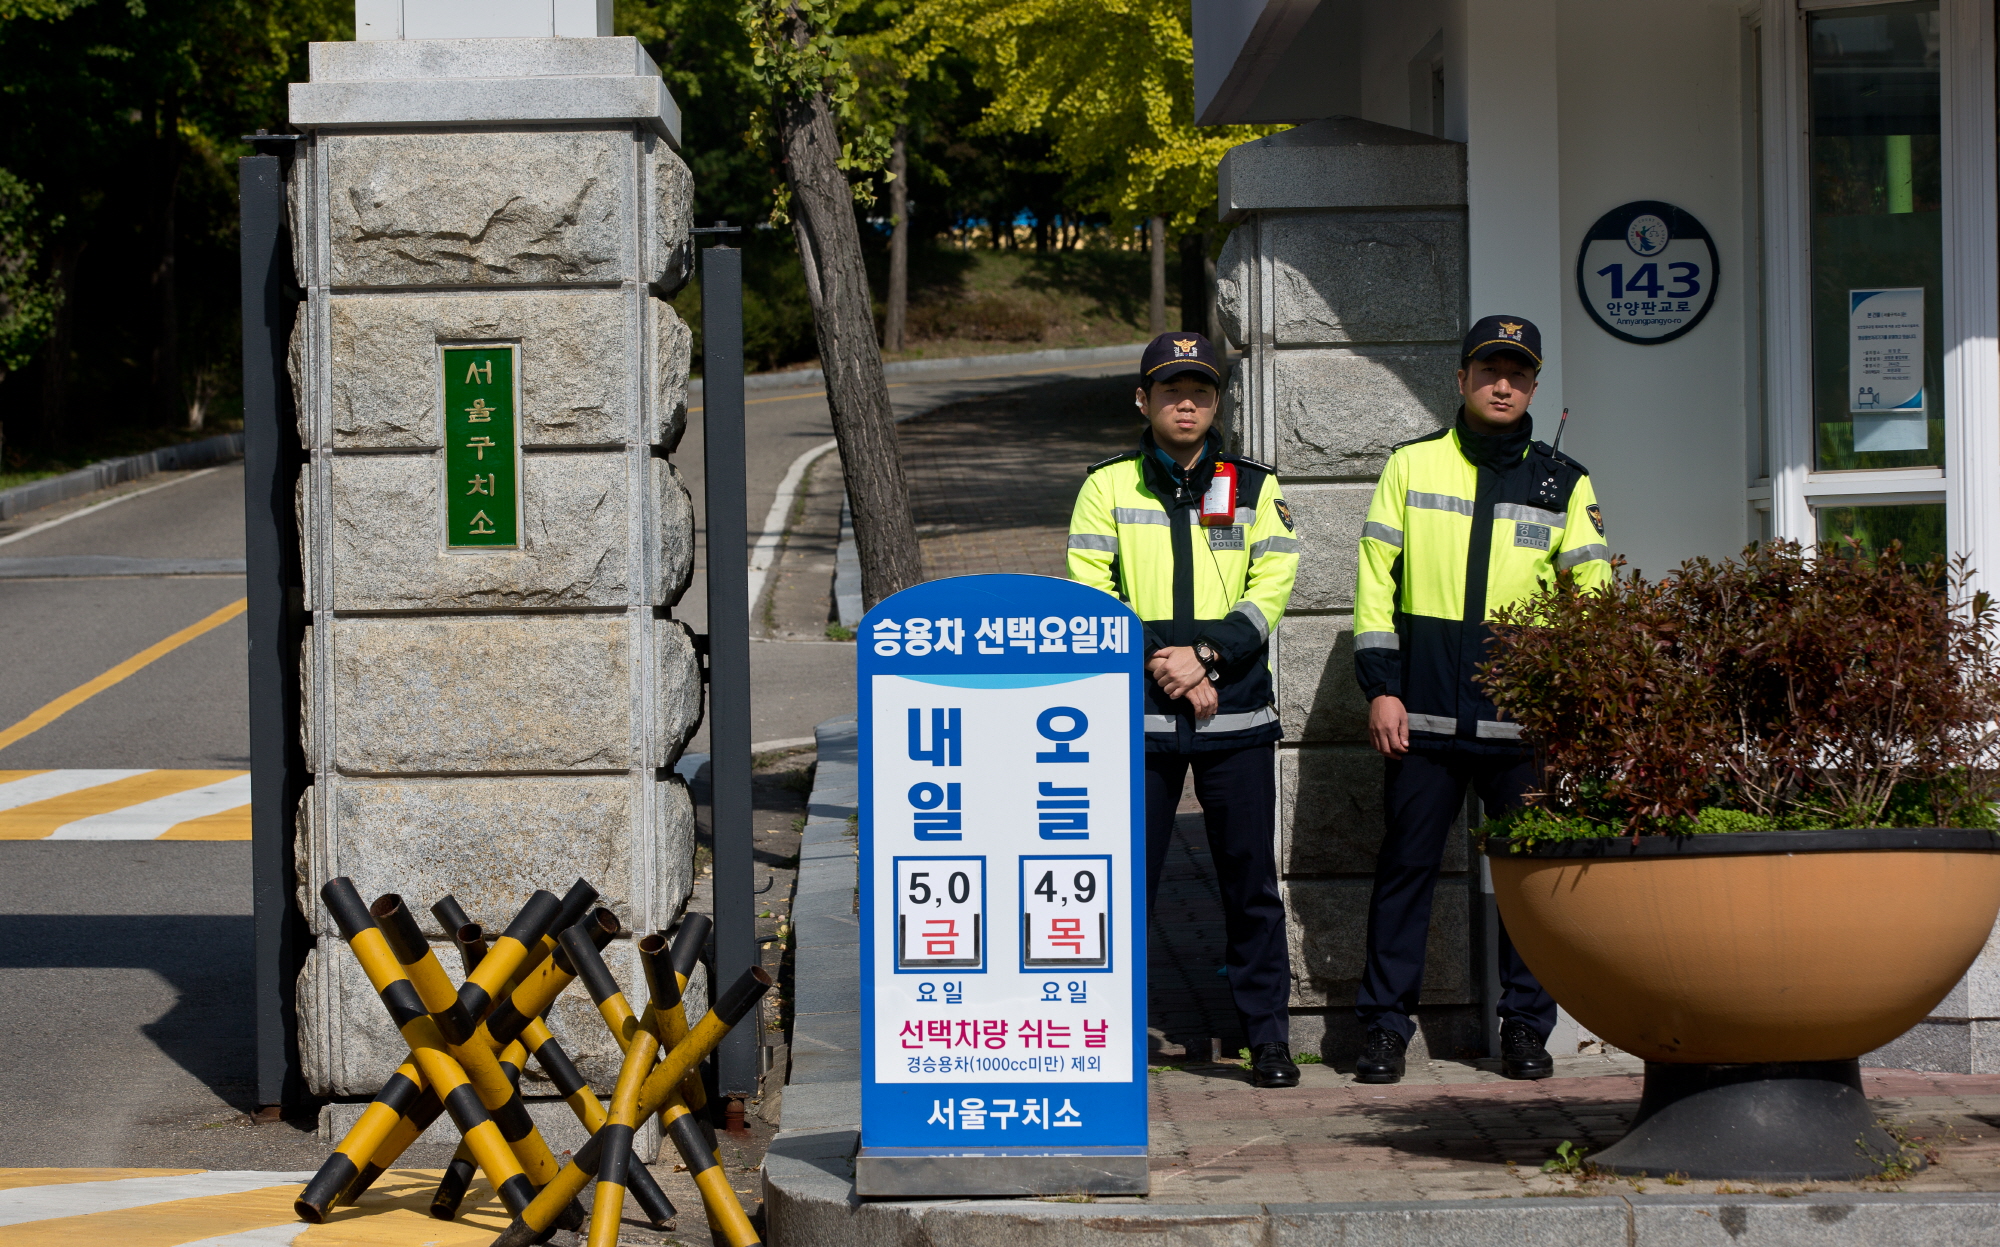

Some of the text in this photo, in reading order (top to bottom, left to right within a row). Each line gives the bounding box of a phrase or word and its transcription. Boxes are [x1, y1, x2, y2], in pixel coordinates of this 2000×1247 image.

[1596, 261, 1701, 299] 143
[1606, 301, 1691, 317] 안양판교로
[464, 360, 497, 535] 서울구치소
[1516, 538, 1548, 548] POLICE
[872, 615, 1130, 657] 승용차 선택요일제
[908, 707, 963, 842] 내일
[1036, 705, 1090, 841] 오늘
[908, 871, 970, 909] 5,0
[1033, 870, 1097, 907] 4,9
[921, 919, 960, 956] 금
[1047, 918, 1086, 955] 목
[899, 1018, 1109, 1050] 선택차량 쉬는 날
[907, 1055, 1101, 1074] 경승용차(1000cc미만) 제외
[926, 1097, 1083, 1131] 서울구치소
